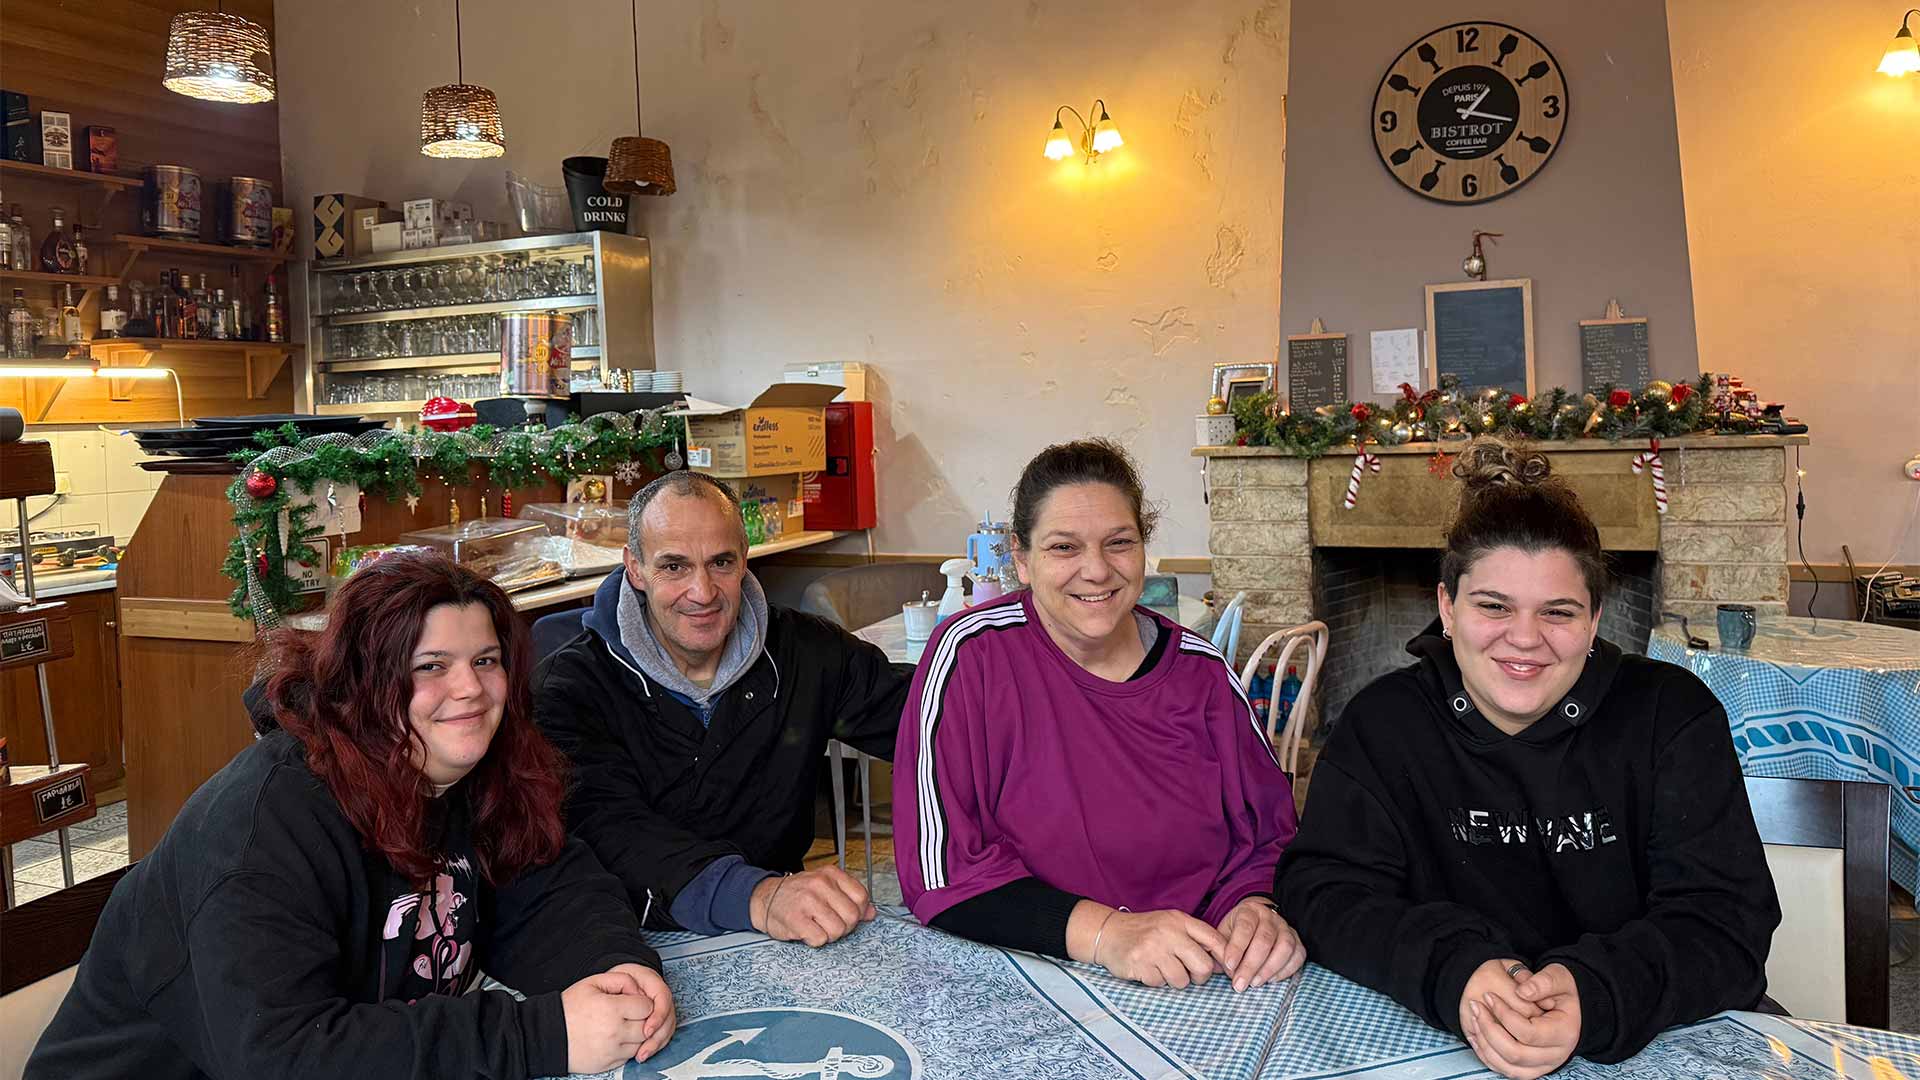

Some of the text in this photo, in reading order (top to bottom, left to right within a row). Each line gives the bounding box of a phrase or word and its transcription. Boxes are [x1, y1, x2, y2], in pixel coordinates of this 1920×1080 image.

[1456, 28, 1479, 53] 12
[1442, 83, 1471, 96] DEPUIS
[1454, 93, 1479, 103] PARIS
[1543, 95, 1560, 118] 3
[1379, 111, 1397, 132] 9
[1430, 123, 1504, 138] BISTROT
[1461, 174, 1477, 197] 6
[587, 195, 623, 207] COLD
[583, 210, 626, 223] DRINKS
[303, 570, 313, 578] NO
[60, 794, 74, 809] 1€
[1449, 808, 1528, 845] NEW
